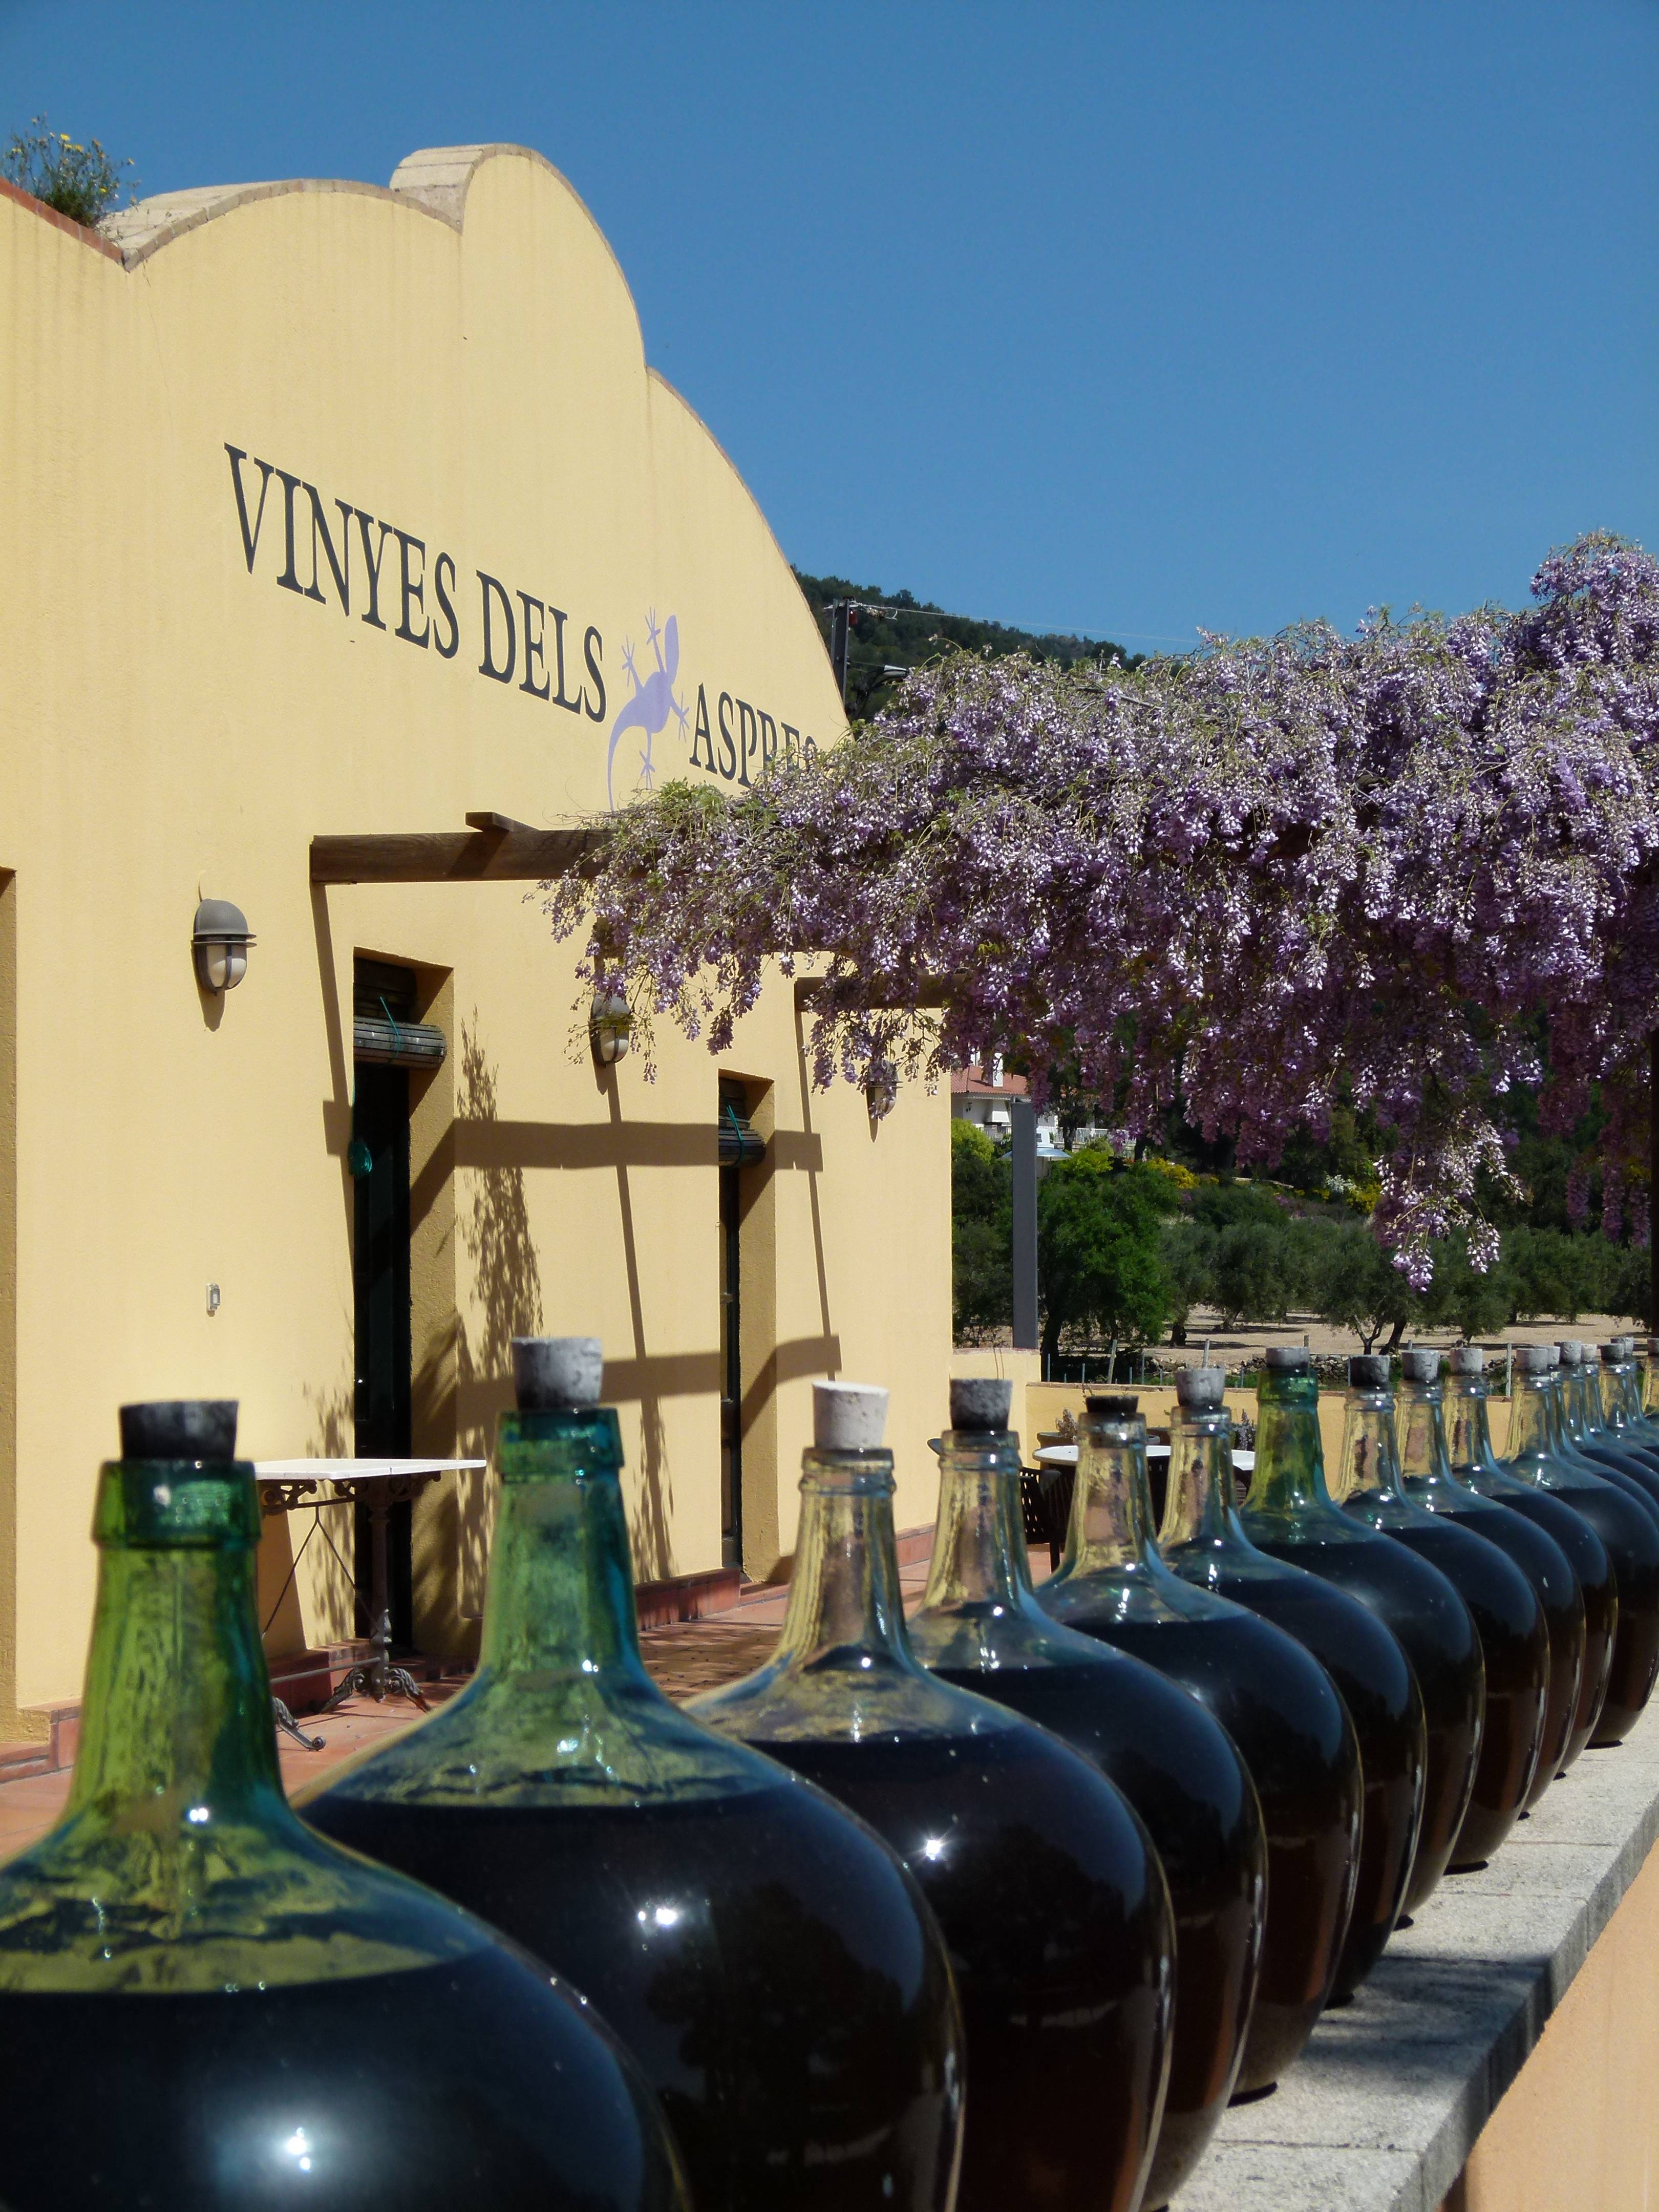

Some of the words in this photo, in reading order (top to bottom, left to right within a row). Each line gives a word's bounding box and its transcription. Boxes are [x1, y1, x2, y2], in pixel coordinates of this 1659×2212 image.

[224, 442, 459, 659] VINYES
[476, 569, 606, 723] DELS
[689, 683, 817, 789] ASPRE
